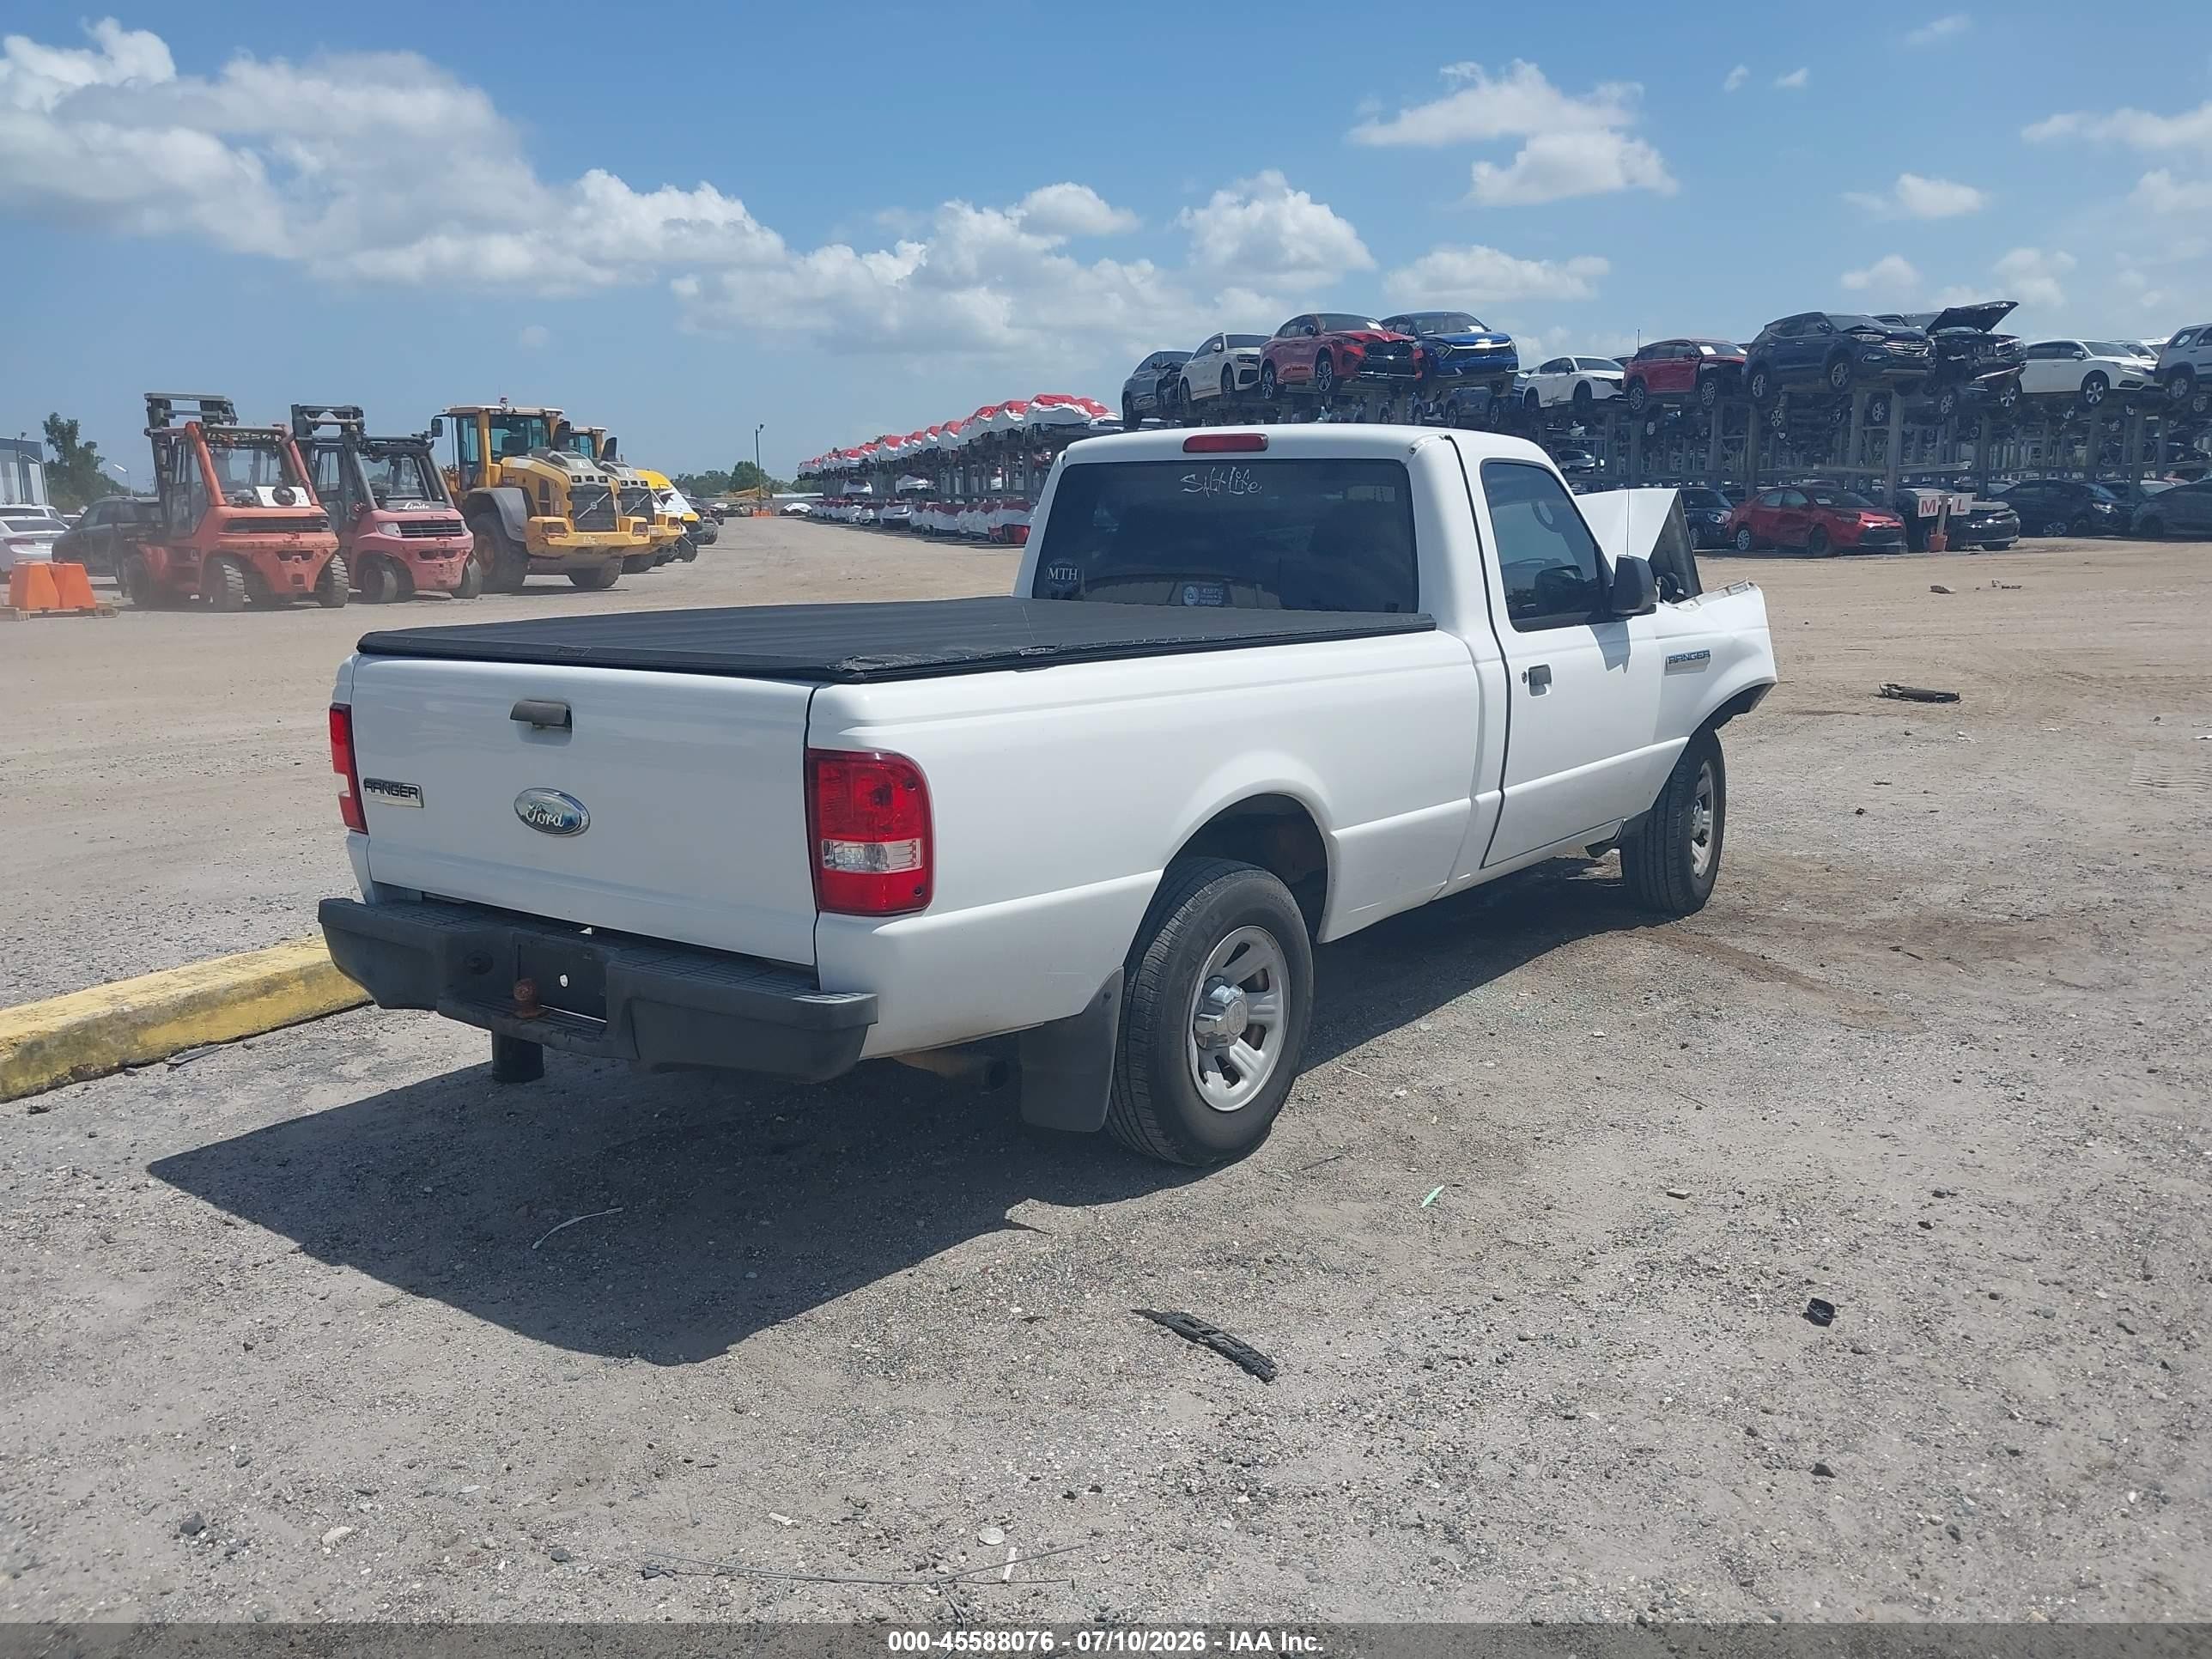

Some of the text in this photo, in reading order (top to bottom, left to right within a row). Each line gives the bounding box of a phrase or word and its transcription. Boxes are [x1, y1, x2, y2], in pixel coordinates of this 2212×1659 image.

[1228, 467, 1262, 495] Life
[398, 501, 430, 510] Linde
[1921, 500, 1936, 514] M
[1957, 498, 1966, 513] L
[1047, 567, 1079, 580] MTH
[1668, 649, 1711, 665] RANGER
[363, 778, 419, 799] RANGER
[526, 803, 565, 829] Ford
